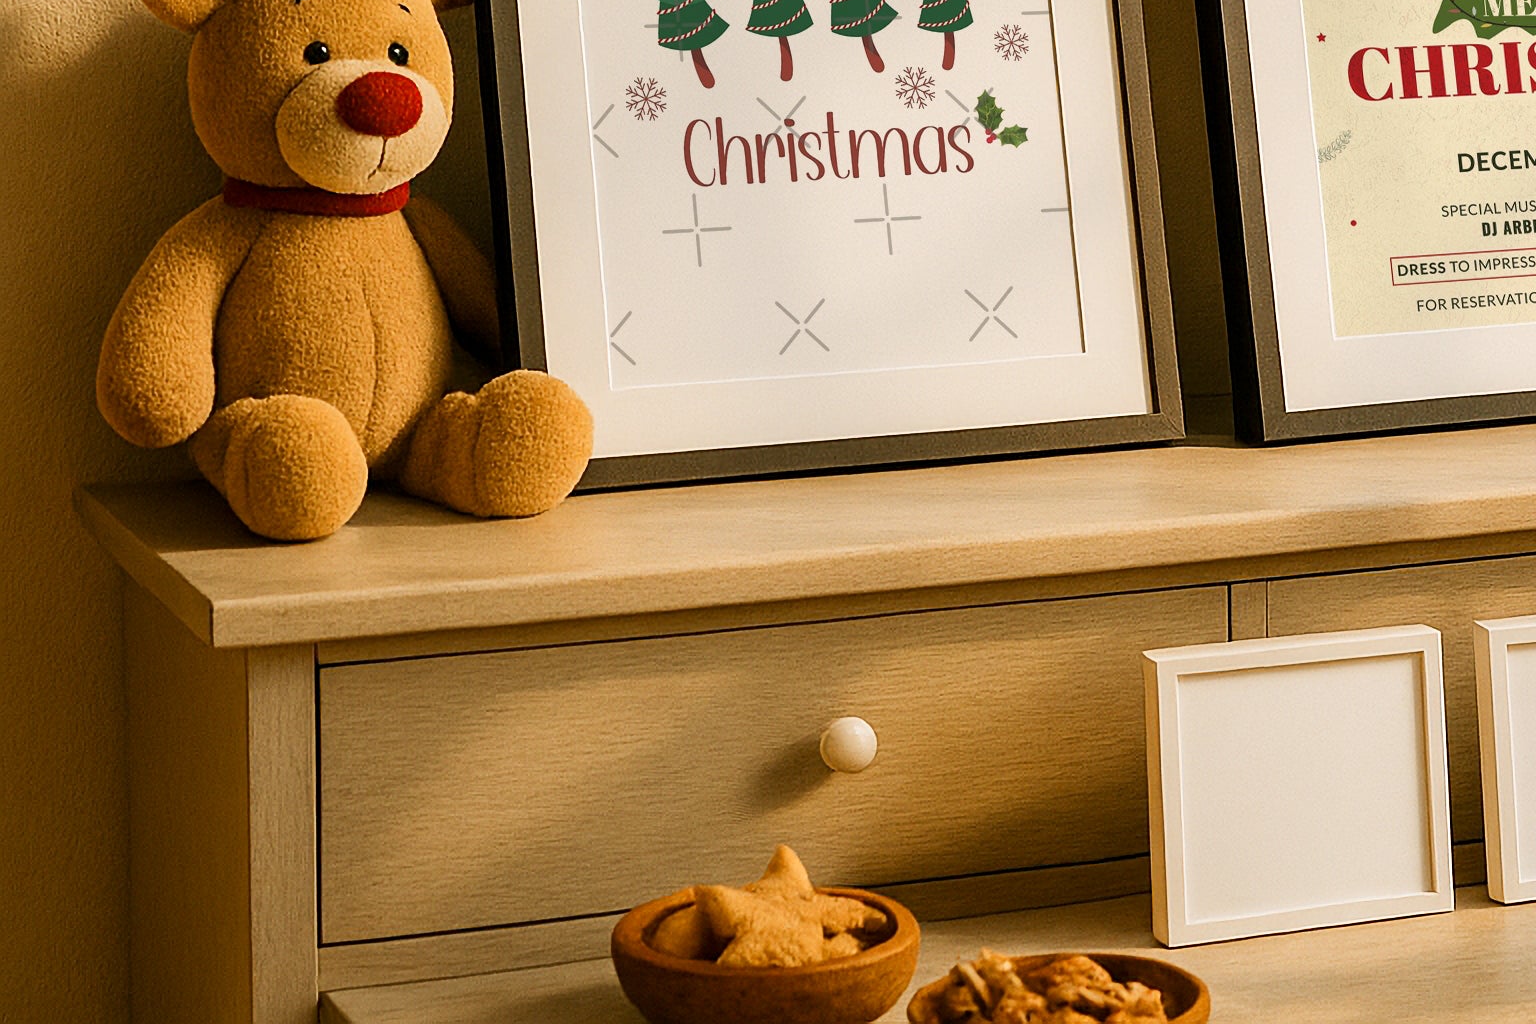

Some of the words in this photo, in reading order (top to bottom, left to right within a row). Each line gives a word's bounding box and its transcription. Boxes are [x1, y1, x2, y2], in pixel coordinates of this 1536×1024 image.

[683, 110, 974, 187] Christmas
[1441, 203, 1501, 218] SPECIAL
[1481, 221, 1498, 237] DJ
[1397, 261, 1446, 277] DRESS
[1449, 260, 1471, 273] TO
[1474, 256, 1536, 271] IMPRESS
[1416, 298, 1449, 312] FOR
